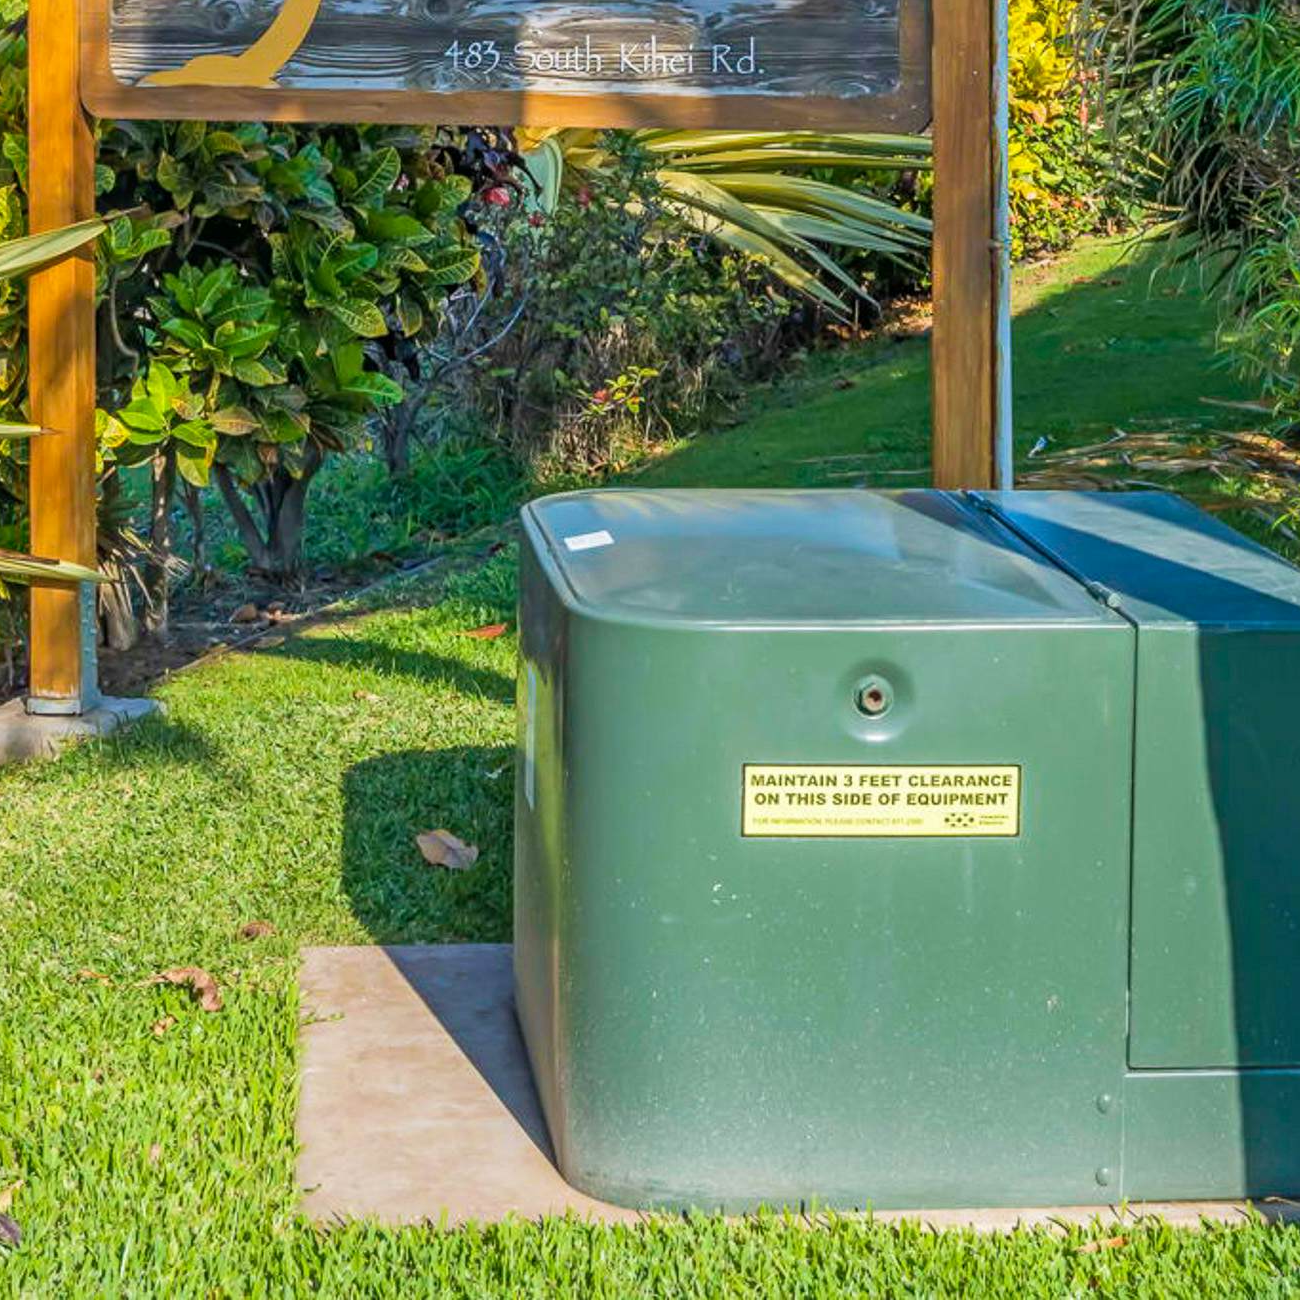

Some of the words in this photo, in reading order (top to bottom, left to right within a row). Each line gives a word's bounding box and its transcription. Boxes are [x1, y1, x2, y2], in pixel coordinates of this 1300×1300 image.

[444, 40, 500, 74] 483
[513, 33, 602, 74] South
[619, 34, 694, 75] Kihei
[711, 36, 766, 75] Rd.
[751, 774, 838, 787] MAINTAIN
[843, 774, 854, 787] 3
[859, 774, 901, 787] FEET
[908, 774, 1013, 787] CLEARANCE
[754, 792, 780, 806] ON
[785, 792, 827, 806] THIS
[832, 792, 872, 806] SIDE
[878, 792, 900, 806] OF
[906, 792, 1009, 806] EQUIPMENT
